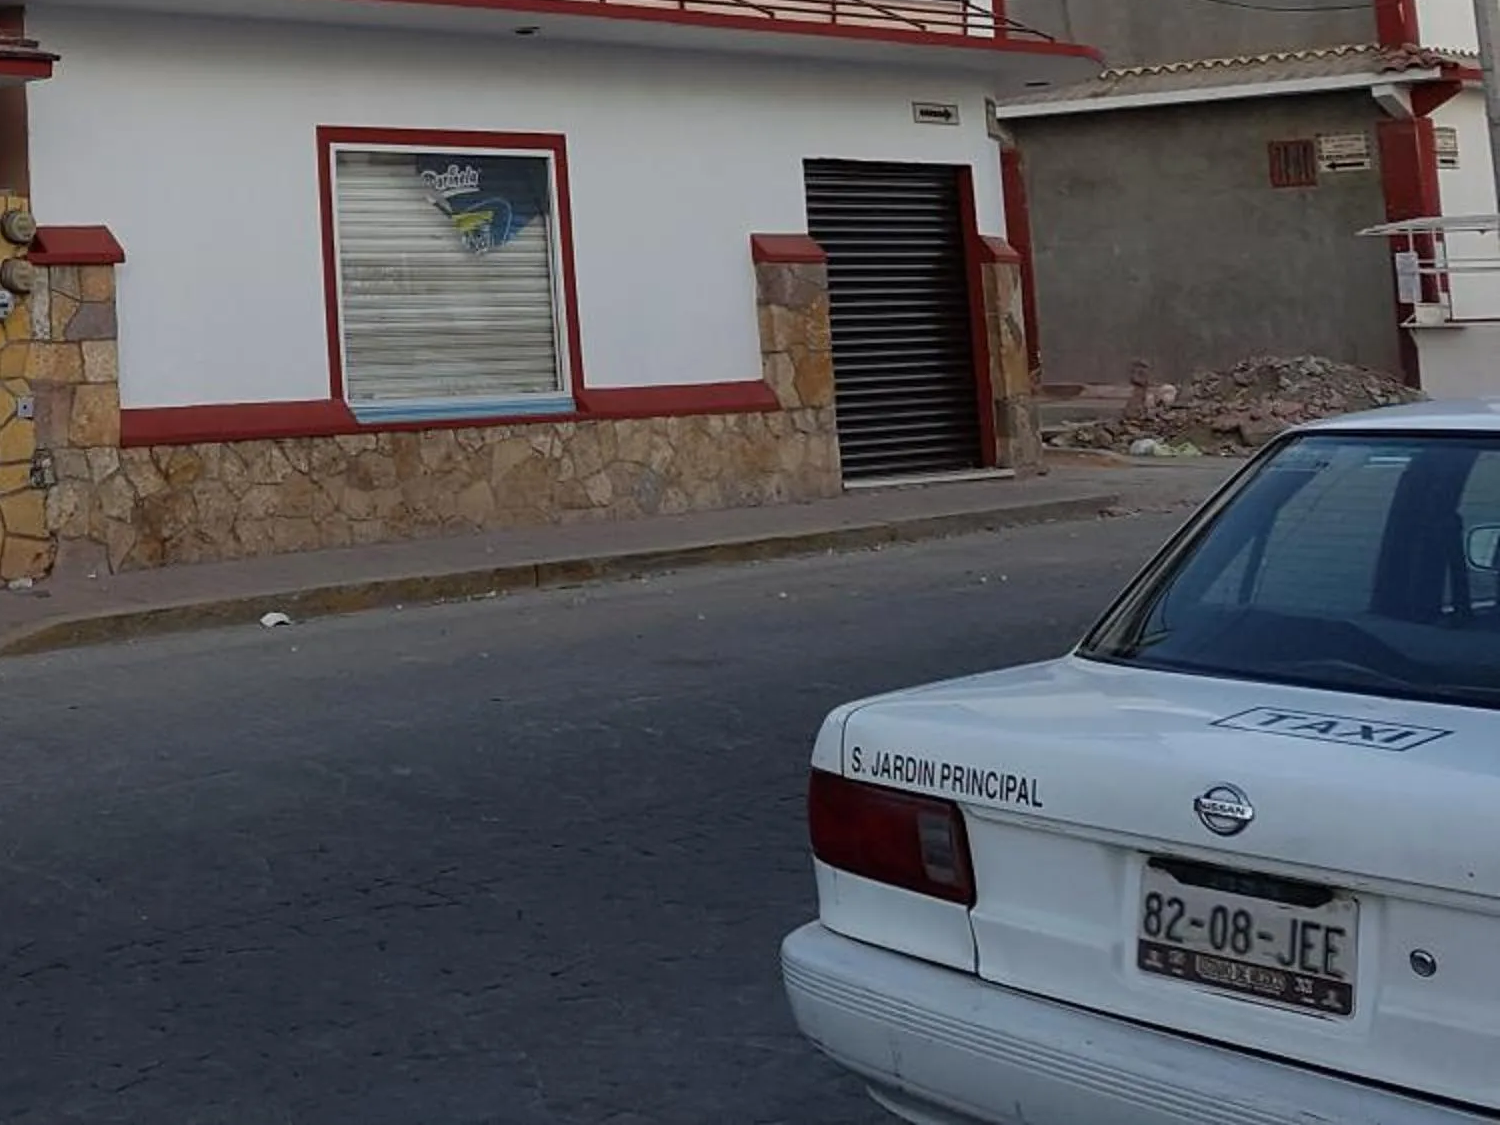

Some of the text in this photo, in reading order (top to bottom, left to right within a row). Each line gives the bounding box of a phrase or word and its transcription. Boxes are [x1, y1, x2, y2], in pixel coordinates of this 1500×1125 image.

[1258, 712, 1418, 743] TAXI
[851, 746, 1044, 809] S. JARDIN PRINCIPAL
[1199, 799, 1246, 817] NISSAN
[1143, 891, 1347, 980] 82-08-JEE
